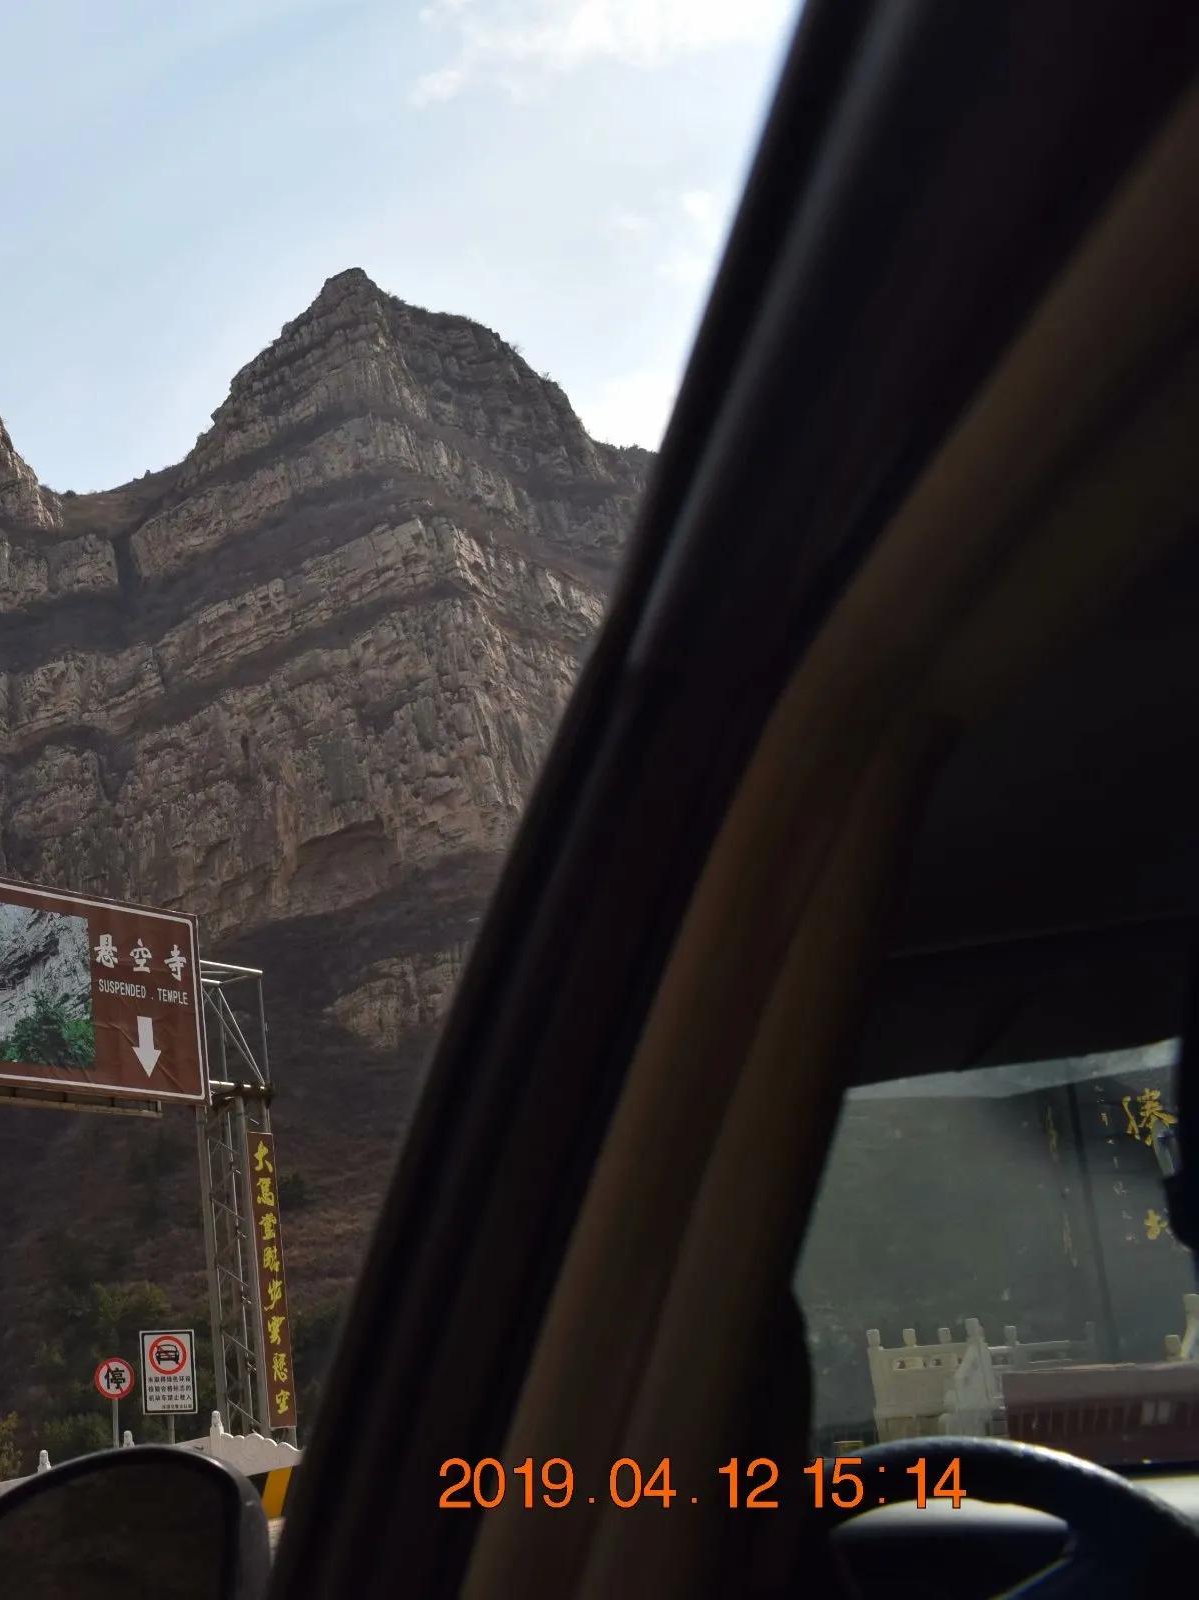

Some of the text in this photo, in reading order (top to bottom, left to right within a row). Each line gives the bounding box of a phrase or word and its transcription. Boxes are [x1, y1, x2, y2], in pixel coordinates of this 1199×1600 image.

[94, 933, 187, 981] 悬空寺
[156, 987, 189, 1006] TEMPLE
[104, 1367, 126, 1390] 停
